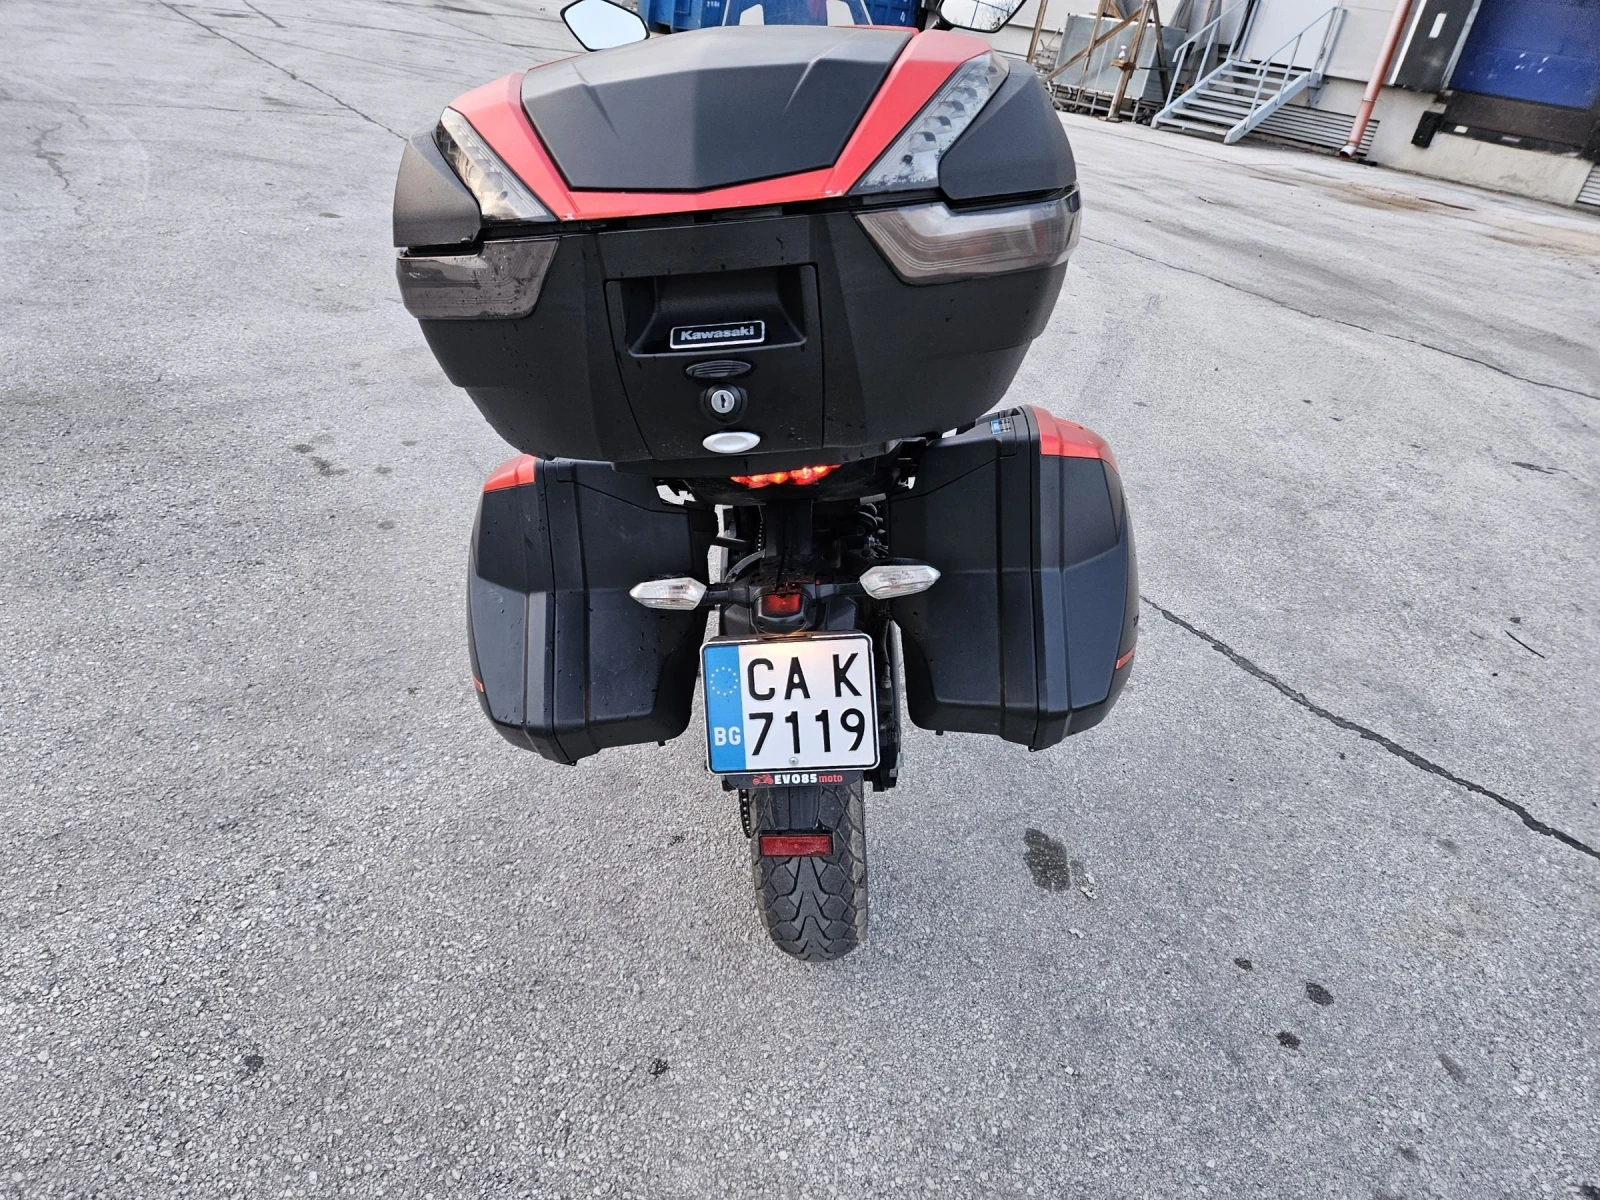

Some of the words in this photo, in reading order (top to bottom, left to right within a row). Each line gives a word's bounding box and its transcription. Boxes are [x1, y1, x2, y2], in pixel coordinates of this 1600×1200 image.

[680, 326, 754, 340] Kawasaki
[713, 726, 741, 746] BG
[748, 707, 866, 756] 7119
